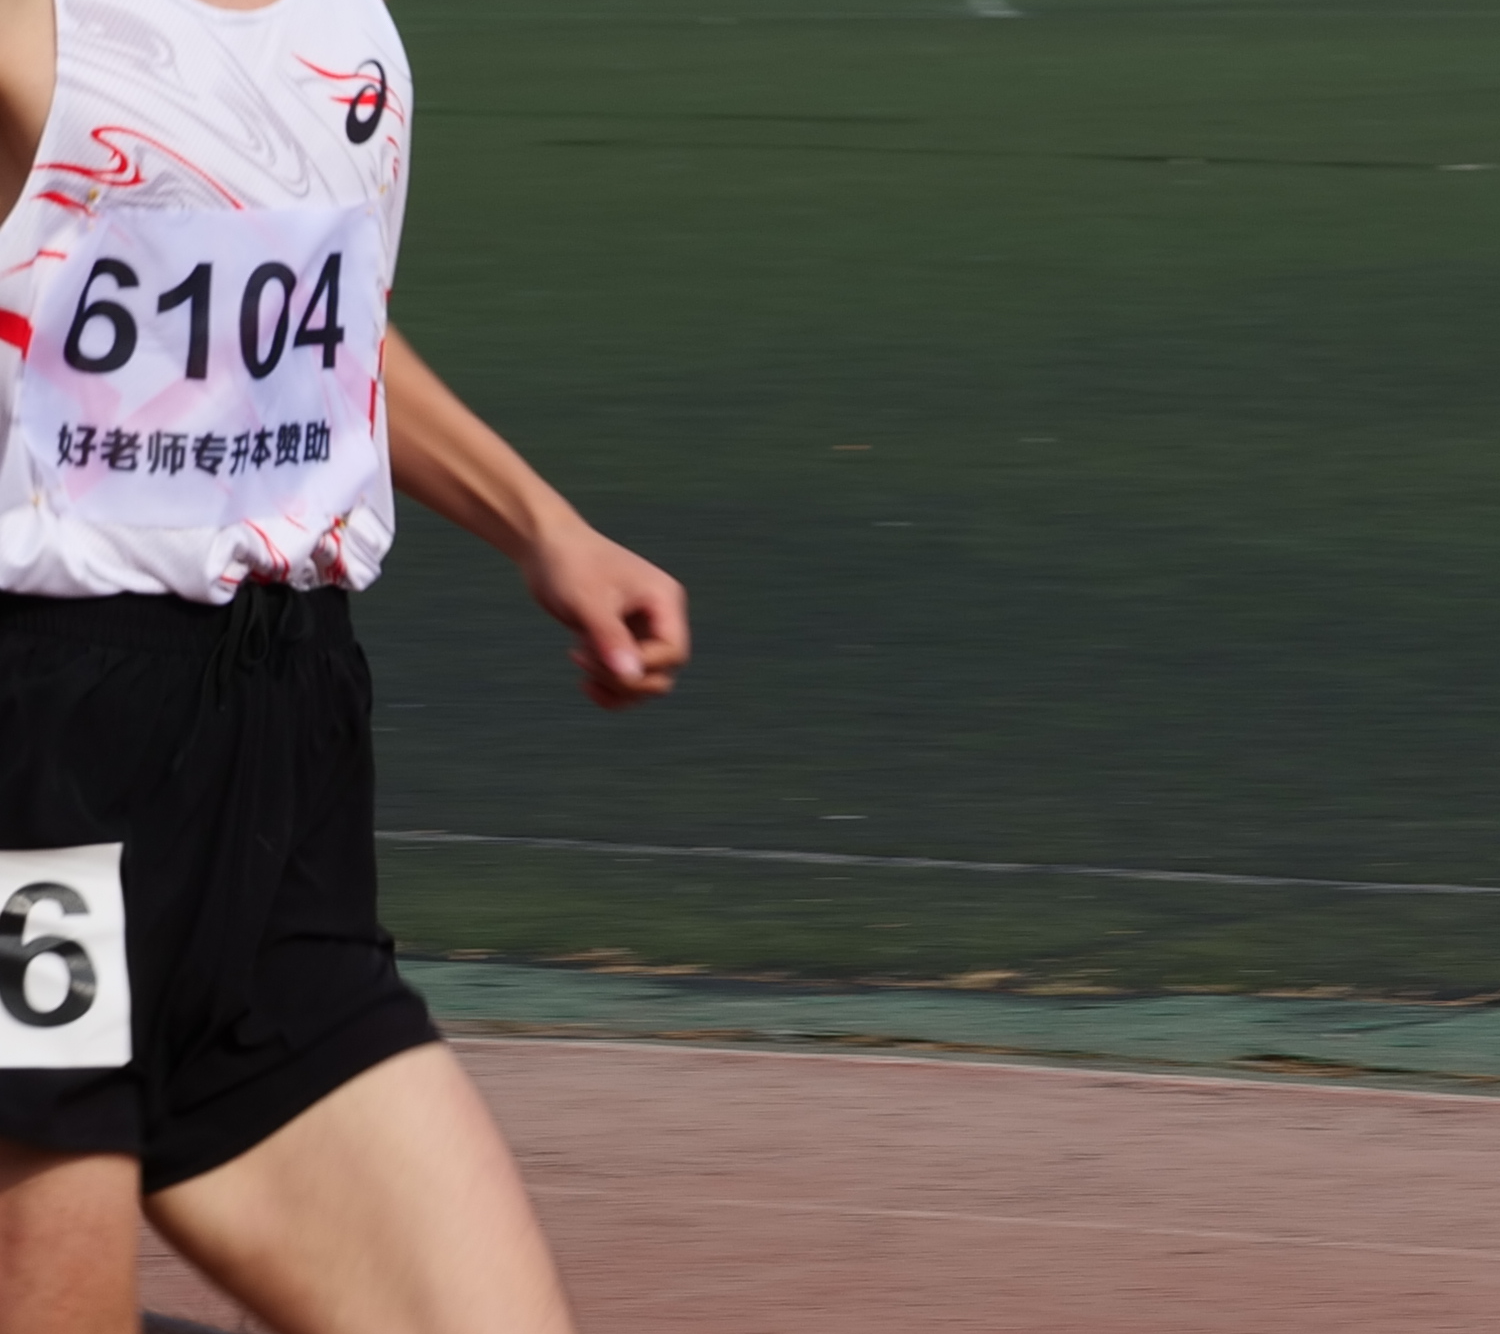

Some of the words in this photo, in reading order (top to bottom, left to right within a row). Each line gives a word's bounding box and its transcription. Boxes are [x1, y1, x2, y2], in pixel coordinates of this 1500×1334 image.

[63, 251, 345, 381] 6104
[56, 419, 331, 478] 好老师专升本赞助
[0, 881, 97, 1029] 6
